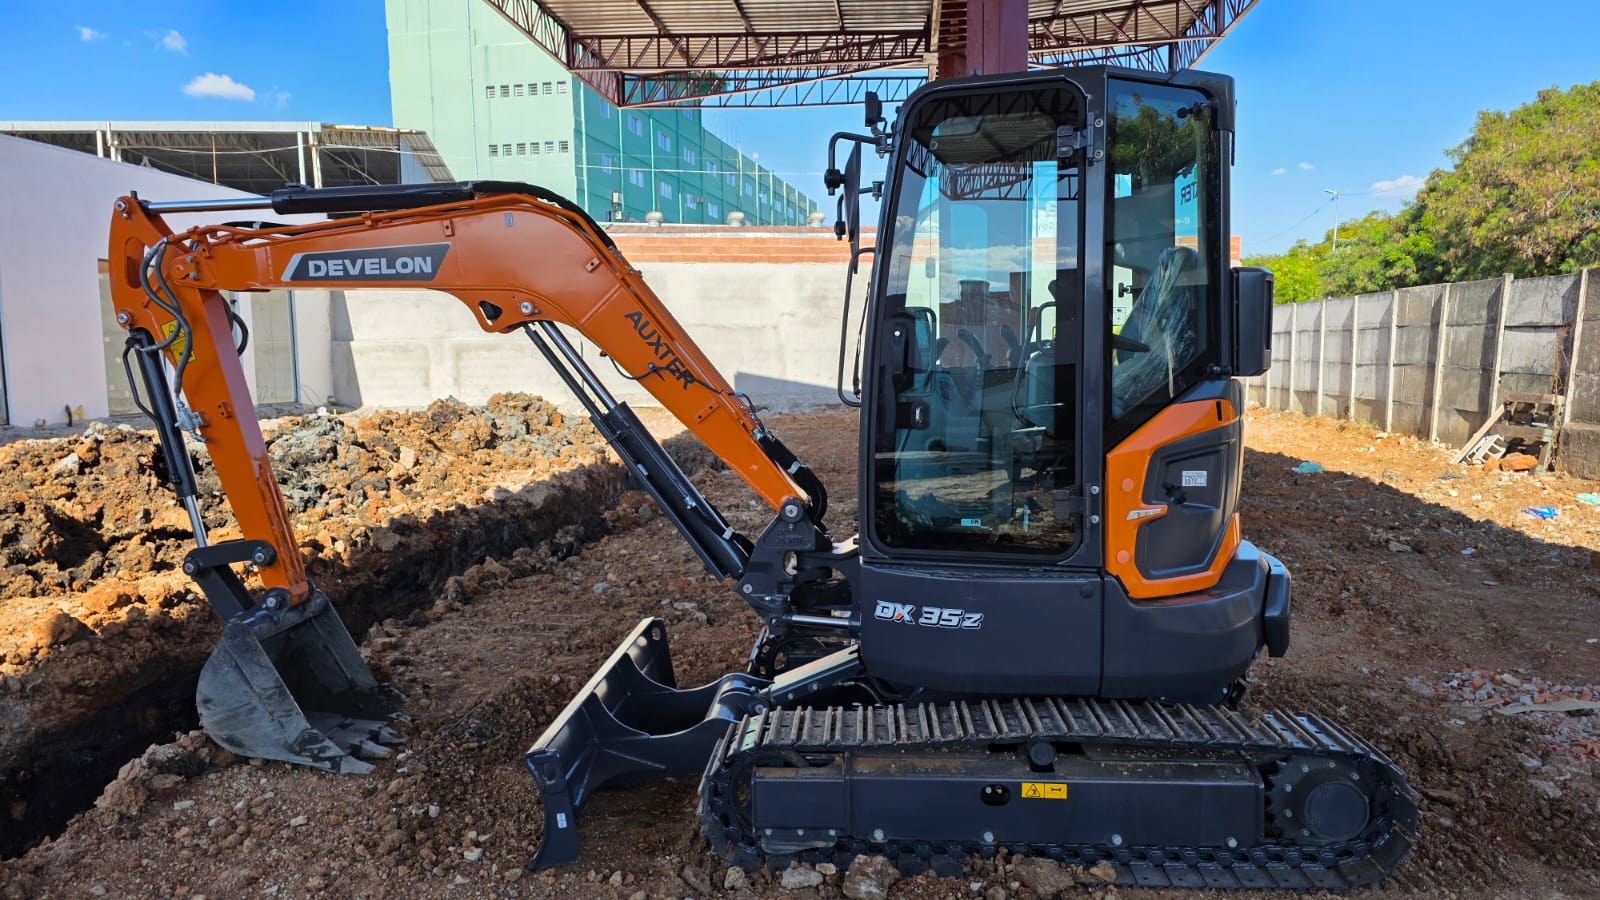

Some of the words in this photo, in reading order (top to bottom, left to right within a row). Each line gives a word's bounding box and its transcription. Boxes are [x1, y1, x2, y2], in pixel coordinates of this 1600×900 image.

[308, 256, 433, 277] DEVELON
[624, 311, 696, 391] AUXTER
[875, 600, 915, 624] DX
